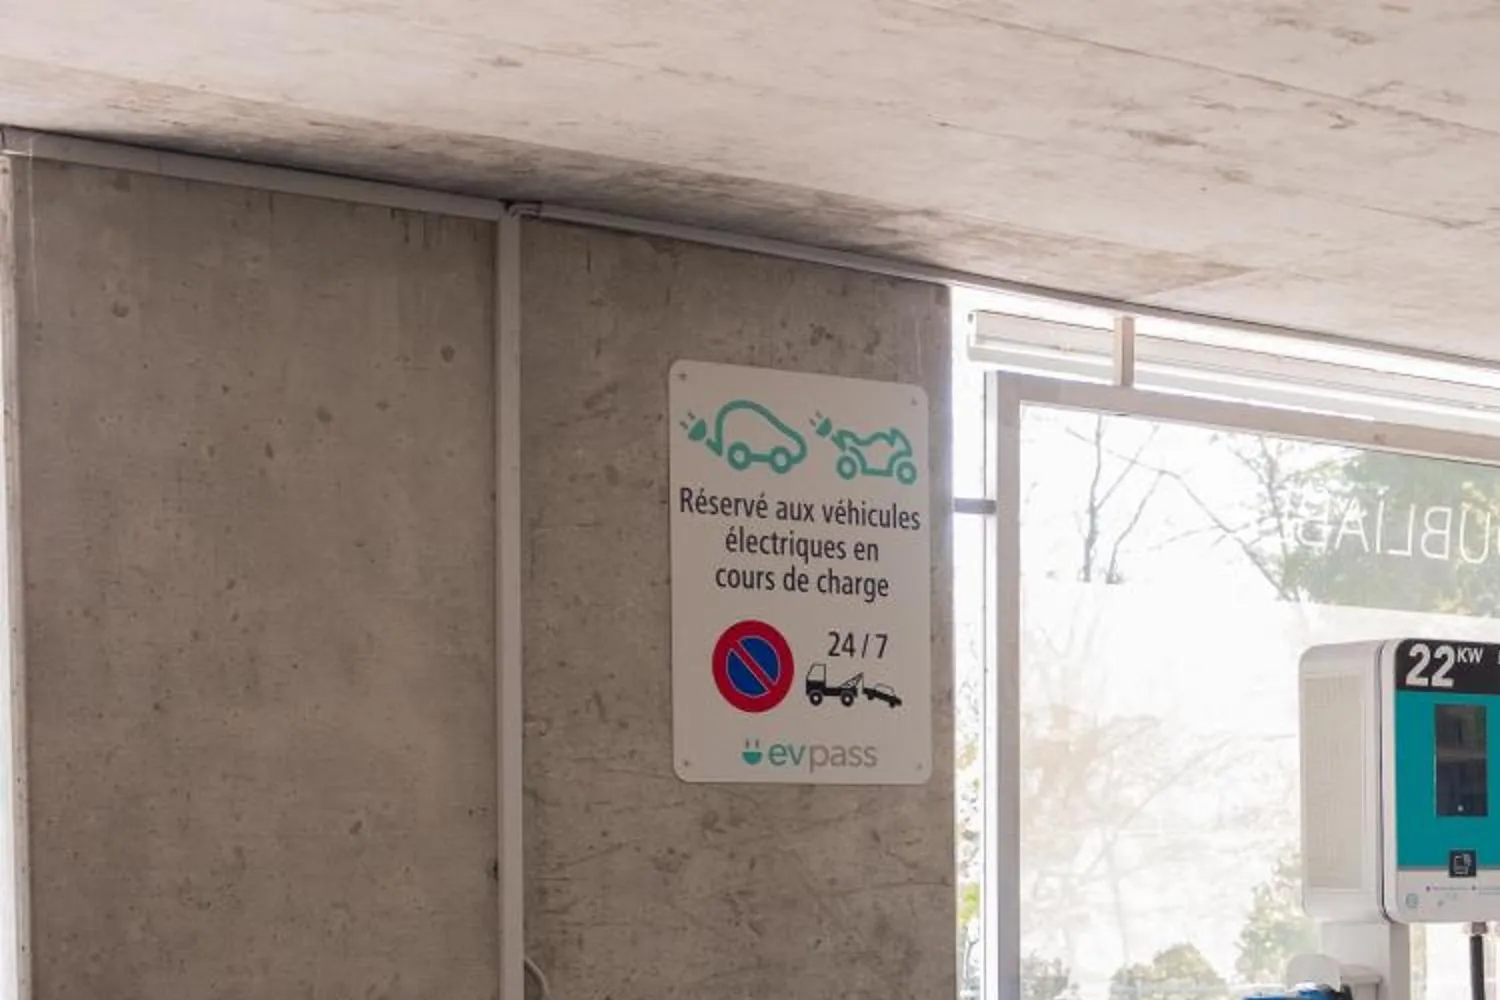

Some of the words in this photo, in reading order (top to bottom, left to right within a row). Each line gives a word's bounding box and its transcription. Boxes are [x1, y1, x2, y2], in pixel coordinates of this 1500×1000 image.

[680, 486, 769, 519] Réservé
[776, 501, 815, 523] aux
[822, 499, 921, 531] véhicules
[725, 526, 847, 564] électriques
[854, 541, 879, 561] en
[715, 567, 775, 592] cours
[783, 566, 809, 593] de
[817, 571, 890, 603] charge
[1405, 643, 1455, 688] 22
[768, 742, 878, 773] evpass
